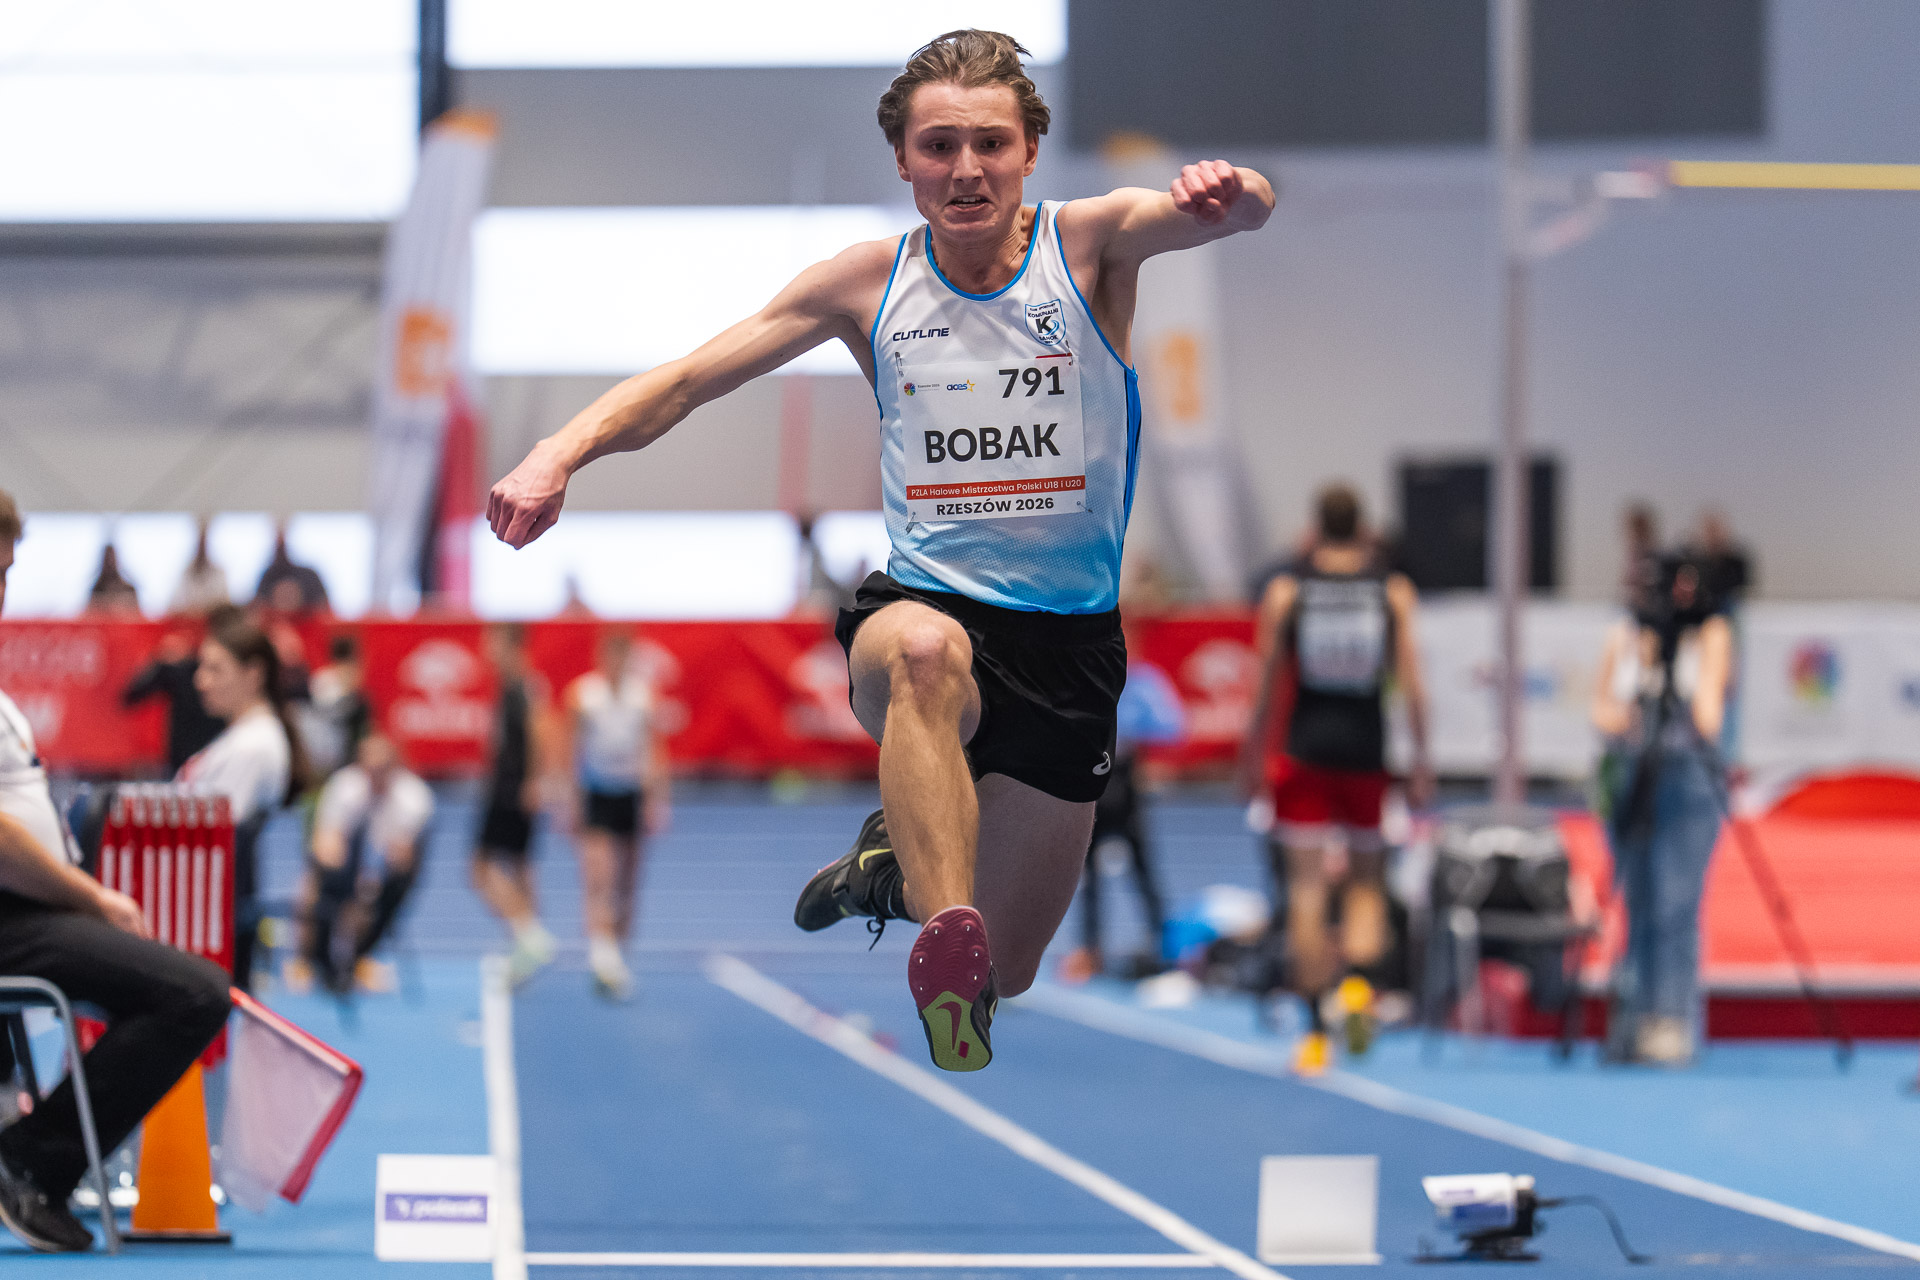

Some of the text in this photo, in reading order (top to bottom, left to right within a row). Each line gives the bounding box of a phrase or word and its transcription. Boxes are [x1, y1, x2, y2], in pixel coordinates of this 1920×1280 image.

[1035, 315, 1052, 333] K
[892, 327, 950, 341] CUTLINE
[946, 383, 968, 391] aces
[998, 366, 1065, 399] 791
[924, 422, 1061, 464] BOBAK
[911, 479, 1082, 497] PZLA Halowe Mistrzostwa Polski U18 i U20
[936, 497, 1054, 516] RZESZÓW 2026
